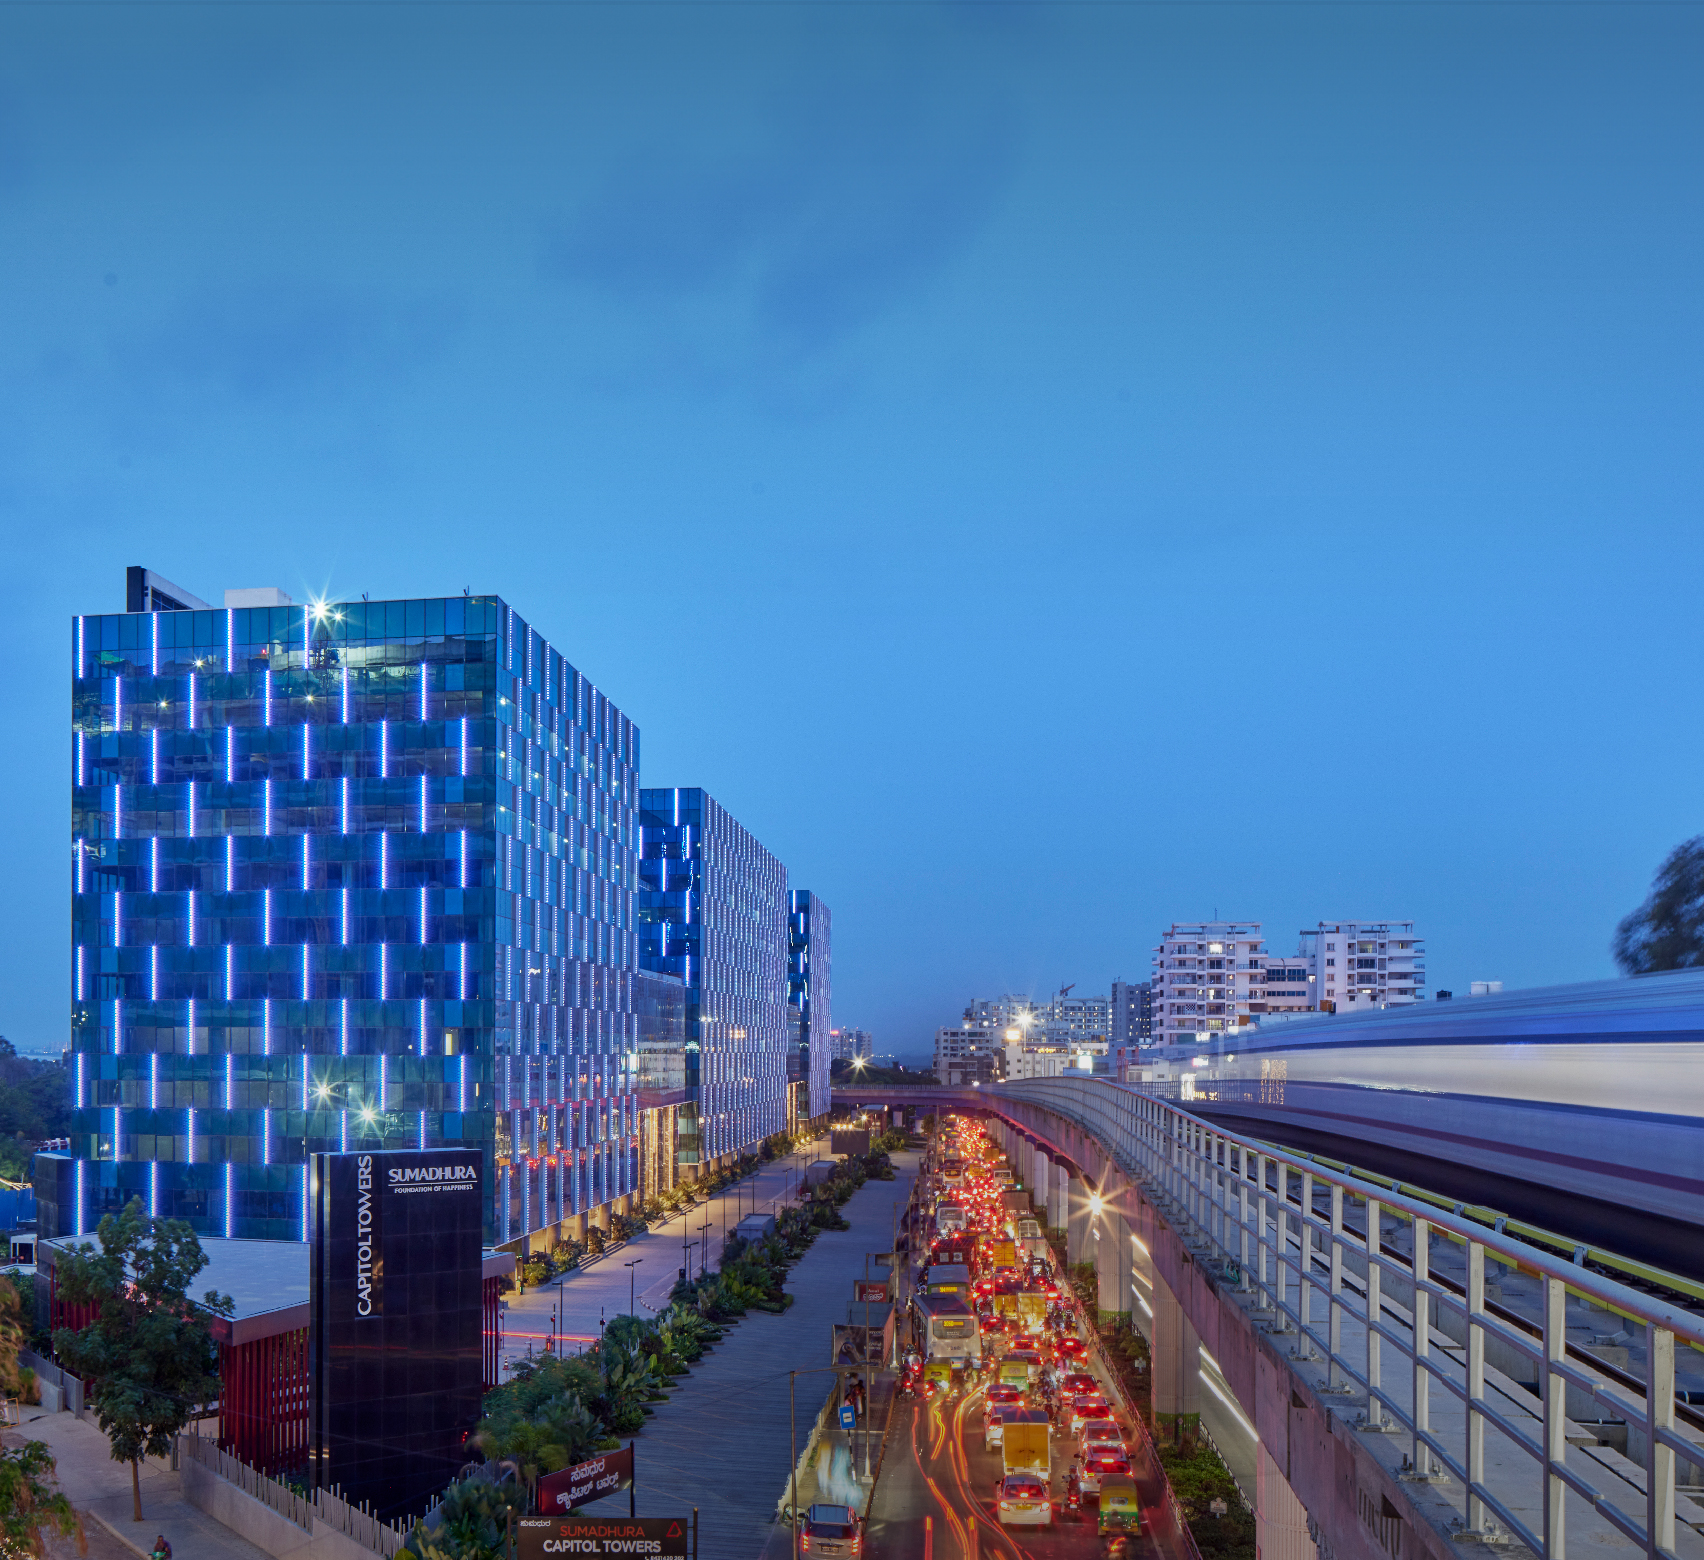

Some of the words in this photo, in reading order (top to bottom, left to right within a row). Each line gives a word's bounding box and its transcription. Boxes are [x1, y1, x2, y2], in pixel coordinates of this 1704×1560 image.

[388, 1166, 477, 1182] SUMADHURA
[394, 1186, 432, 1194] FOUNDATION
[571, 1459, 605, 1482] ಸುಮಧುರ
[560, 1525, 646, 1538] SUMADHURA
[543, 1539, 601, 1553] CAPITOL
[602, 1539, 662, 1553] TOWERS
